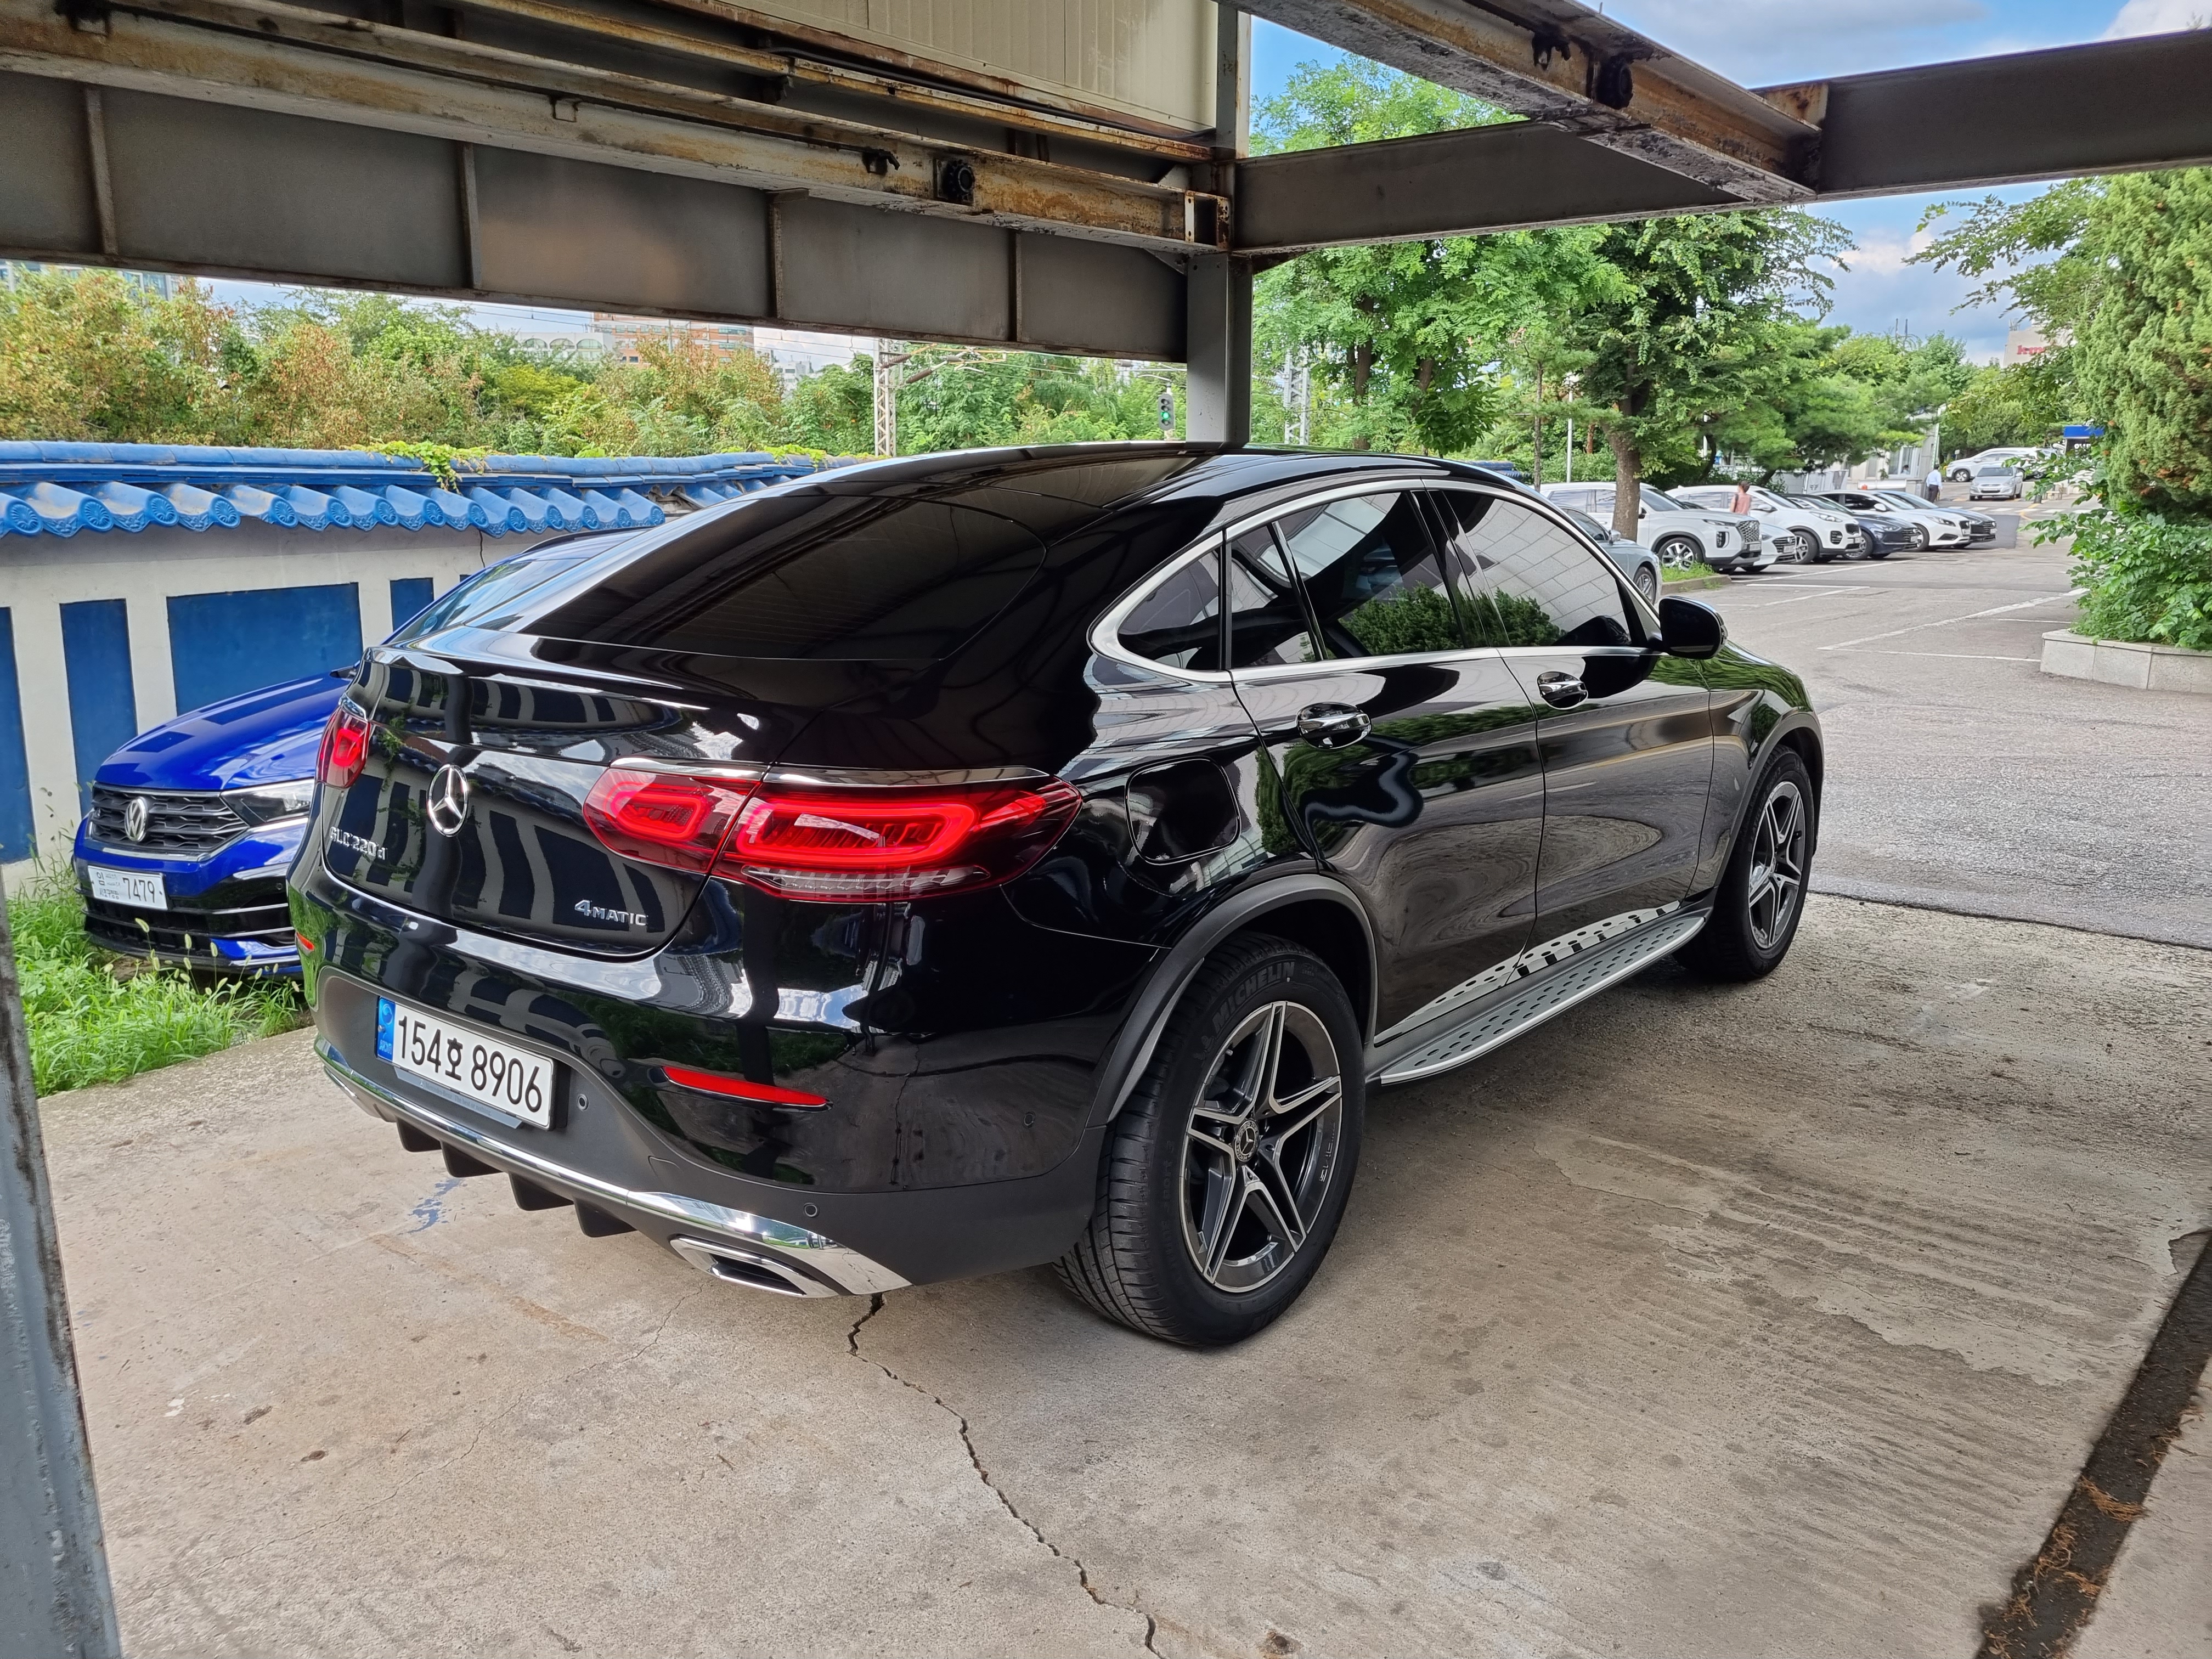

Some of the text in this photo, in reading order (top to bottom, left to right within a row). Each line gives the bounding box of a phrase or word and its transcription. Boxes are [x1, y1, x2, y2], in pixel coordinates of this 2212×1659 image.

[122, 877, 155, 903] 7479
[574, 899, 649, 926] 4MATIC
[1212, 962, 1295, 1034] MICHELIN
[471, 1045, 543, 1113] 8906
